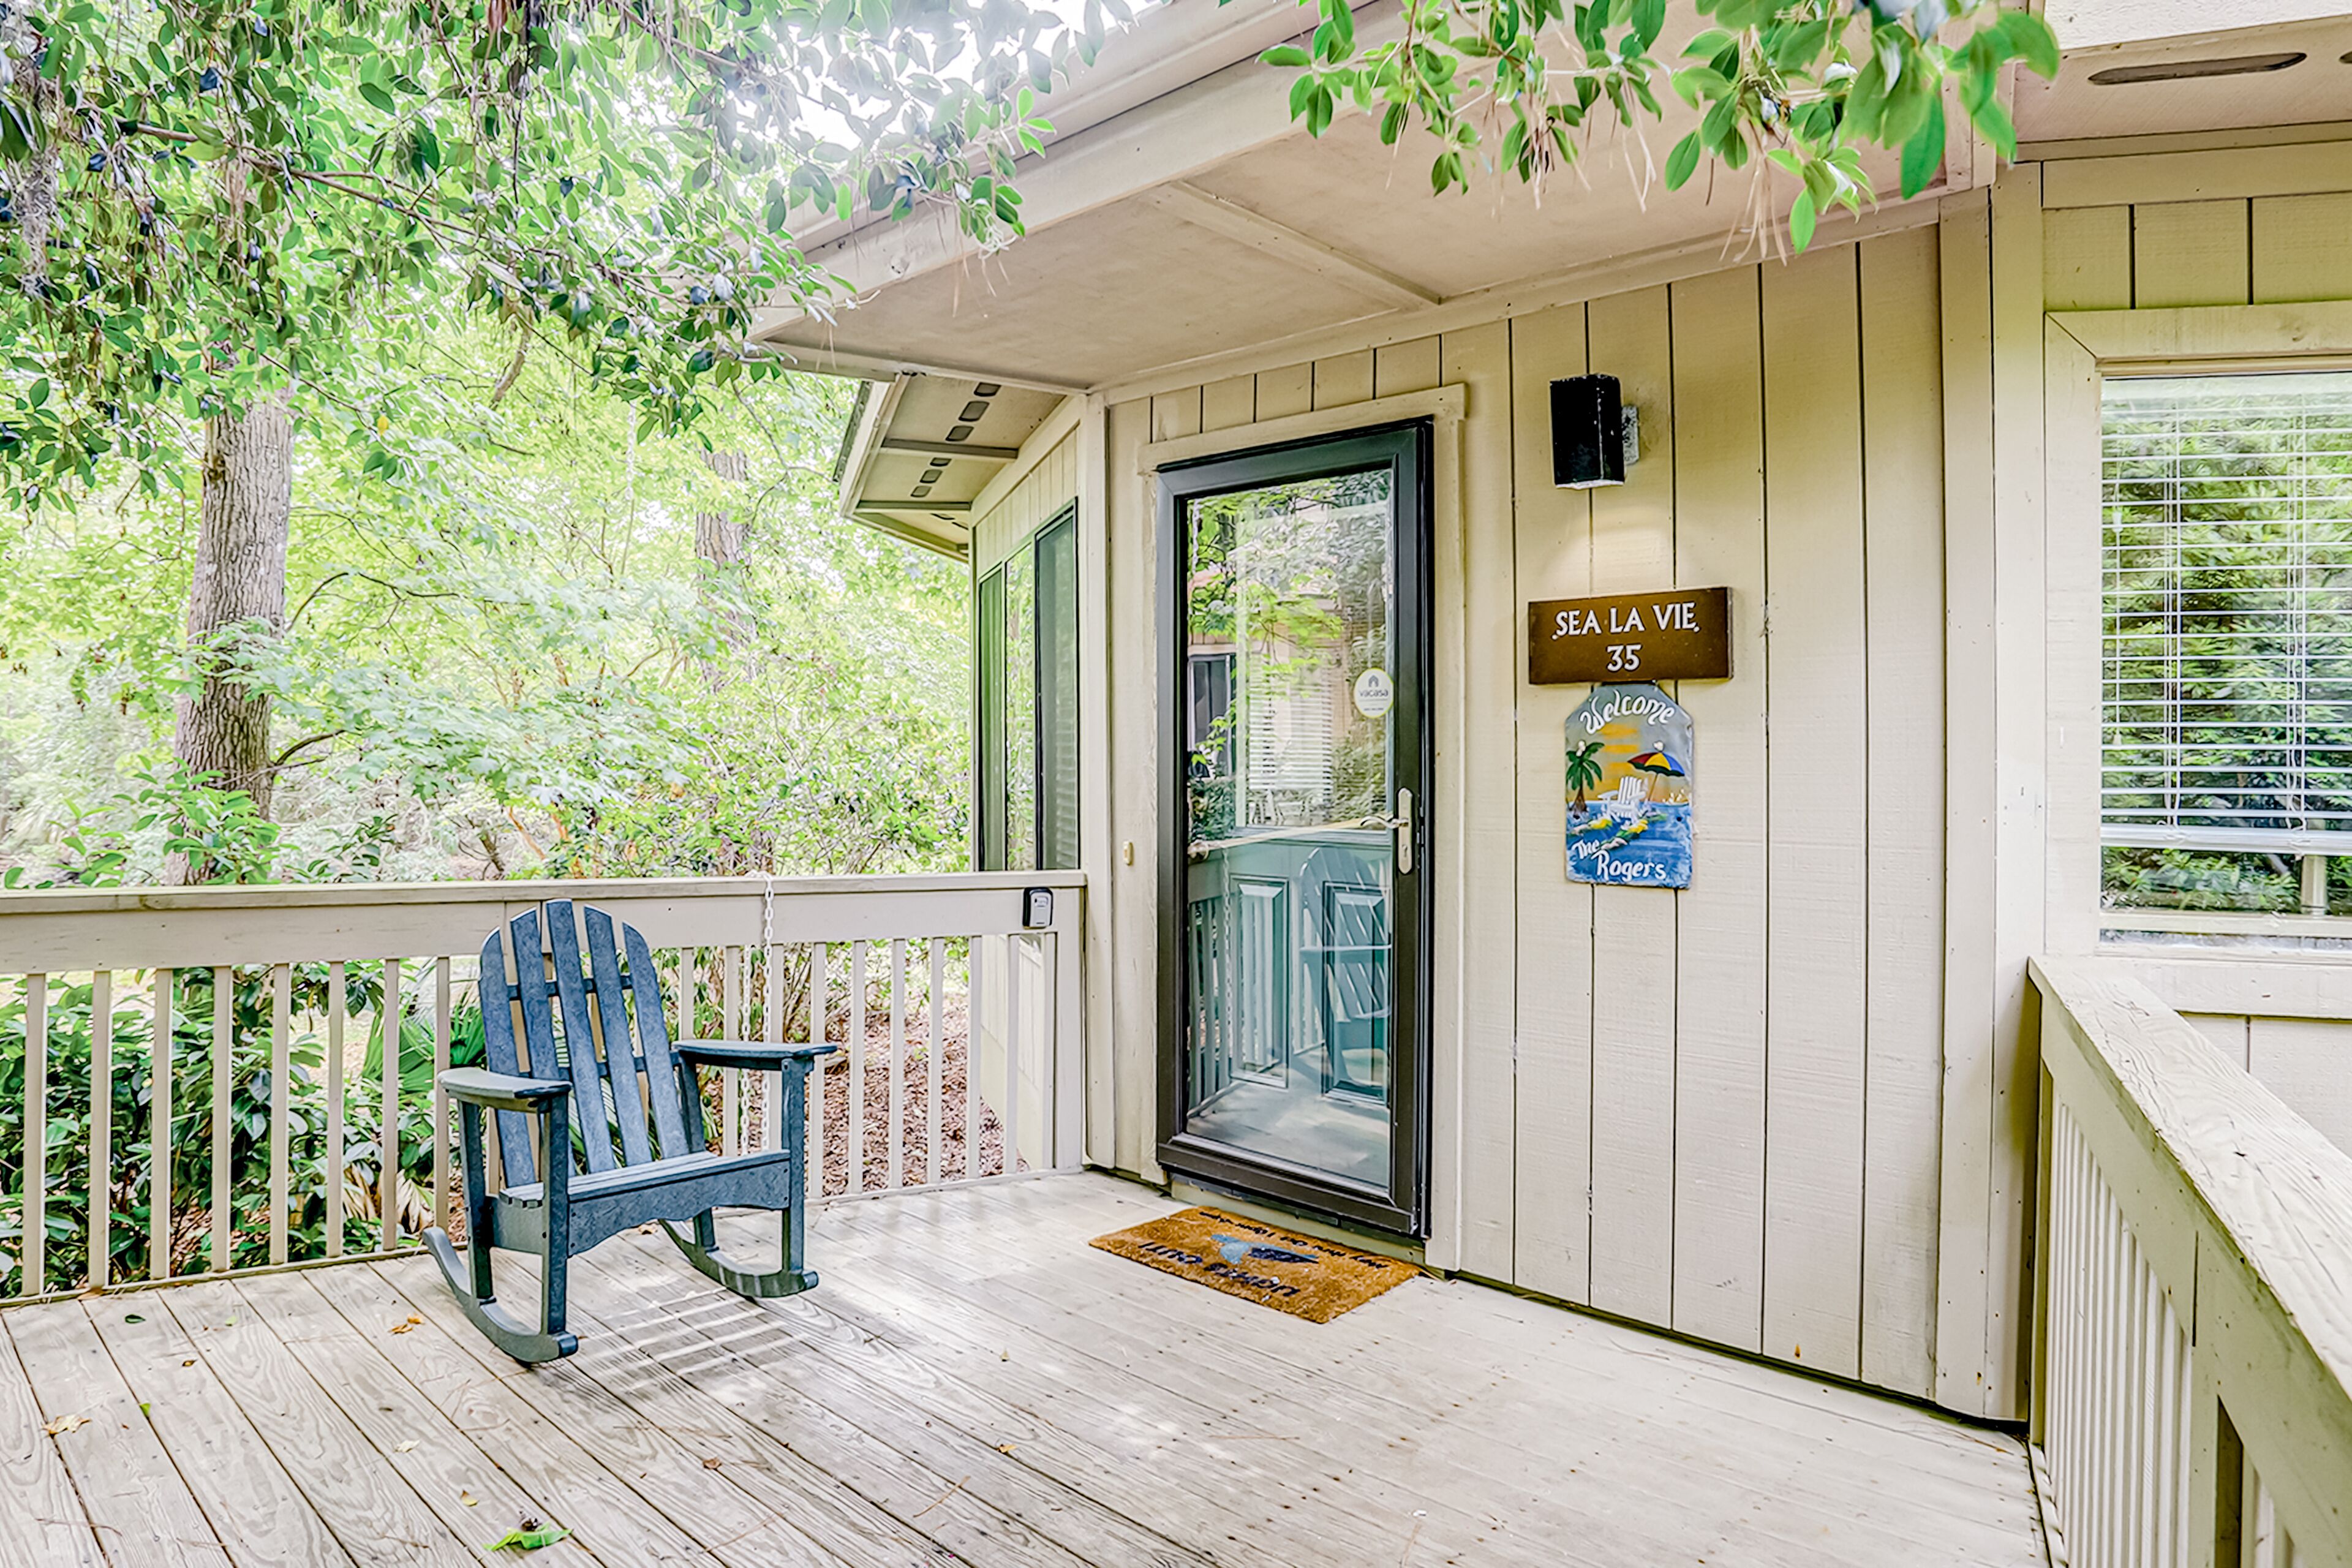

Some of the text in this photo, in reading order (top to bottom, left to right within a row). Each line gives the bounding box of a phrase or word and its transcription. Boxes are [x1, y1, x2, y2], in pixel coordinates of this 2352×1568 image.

[1555, 602, 1697, 636] SEA LA VIE
[1607, 644, 1642, 672] 35
[1580, 689, 1675, 735] Welcome
[1572, 839, 1600, 860] The
[1591, 850, 1667, 882] Rogers
